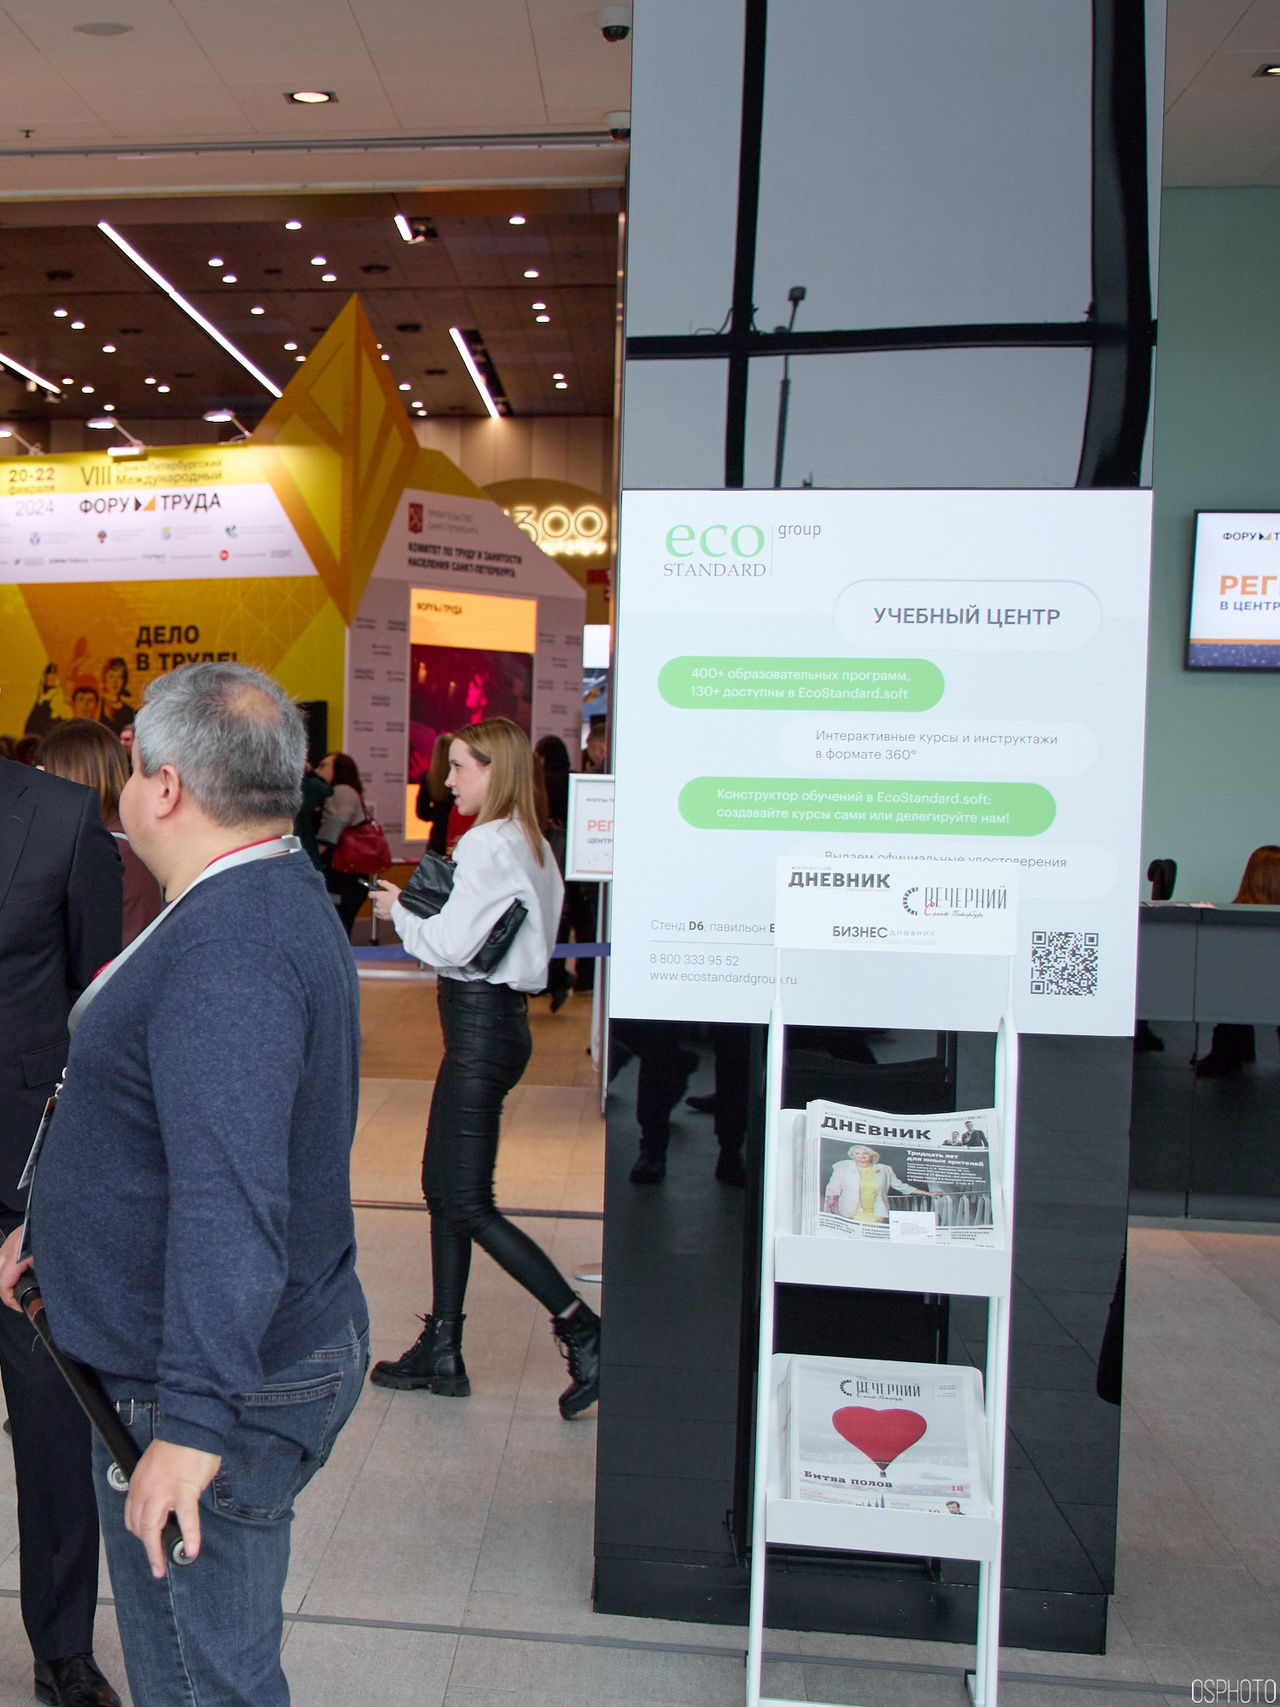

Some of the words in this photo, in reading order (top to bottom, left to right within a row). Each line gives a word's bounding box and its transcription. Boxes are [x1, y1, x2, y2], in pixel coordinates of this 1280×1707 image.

[9, 467, 55, 482] 20-22
[80, 466, 111, 486] VIII
[16, 500, 54, 517] 2024
[161, 493, 222, 512] ТРУДА
[665, 524, 765, 558] eco
[778, 524, 822, 539] group
[663, 563, 767, 577] STANDARD
[1220, 575, 1280, 596] РЕГ
[1220, 601, 1229, 611] В
[873, 604, 980, 625] УЧЕБНЫЙ
[987, 608, 1061, 629] ЦЕНТР
[136, 625, 199, 648] ДЕЛО
[136, 653, 150, 671] В
[691, 667, 724, 679] 400+
[728, 668, 838, 681] образовательных
[842, 670, 910, 683] программ,
[691, 686, 720, 697] 130+
[723, 688, 784, 699] доступны
[788, 689, 795, 698] в
[798, 687, 908, 700] EcoStandard.soft
[816, 730, 916, 743] Интерактивные
[919, 733, 958, 745] курсы
[962, 735, 970, 743] и
[974, 734, 1058, 746] инструктажи
[816, 750, 822, 759] в
[825, 748, 882, 761] формате
[885, 749, 916, 761] 360°
[717, 788, 799, 803] Конструктор
[801, 789, 862, 803] обучений
[866, 794, 874, 802] в
[877, 791, 992, 805] EcoStandard.soft:
[716, 807, 789, 819] создавайте
[792, 810, 831, 821] курсы
[834, 811, 866, 820] сами
[869, 812, 893, 821] или
[895, 811, 978, 824] делегируйте
[981, 813, 1010, 823] нам!
[788, 872, 890, 888] ДНЕВНИК
[925, 885, 1007, 909] ВЕЧЕРНИЙ
[650, 920, 685, 932] Стенд
[689, 921, 706, 932] D6,
[710, 923, 766, 933] павильон
[832, 926, 888, 938] БИЗНЕС
[649, 953, 656, 964] 8
[660, 954, 681, 965] 800
[684, 954, 705, 965] 333
[708, 955, 722, 966] 95
[725, 956, 739, 966] 52
[650, 971, 797, 986] www.ecostandardgrou.ru
[820, 1115, 932, 1140] ДНЕВНИК
[906, 1150, 944, 1158] Тридцать
[948, 1159, 984, 1167] зрителей
[856, 1380, 921, 1397] ВЕЧЕРНИЙ
[804, 1470, 846, 1484] Битва
[851, 1478, 893, 1488] полов
